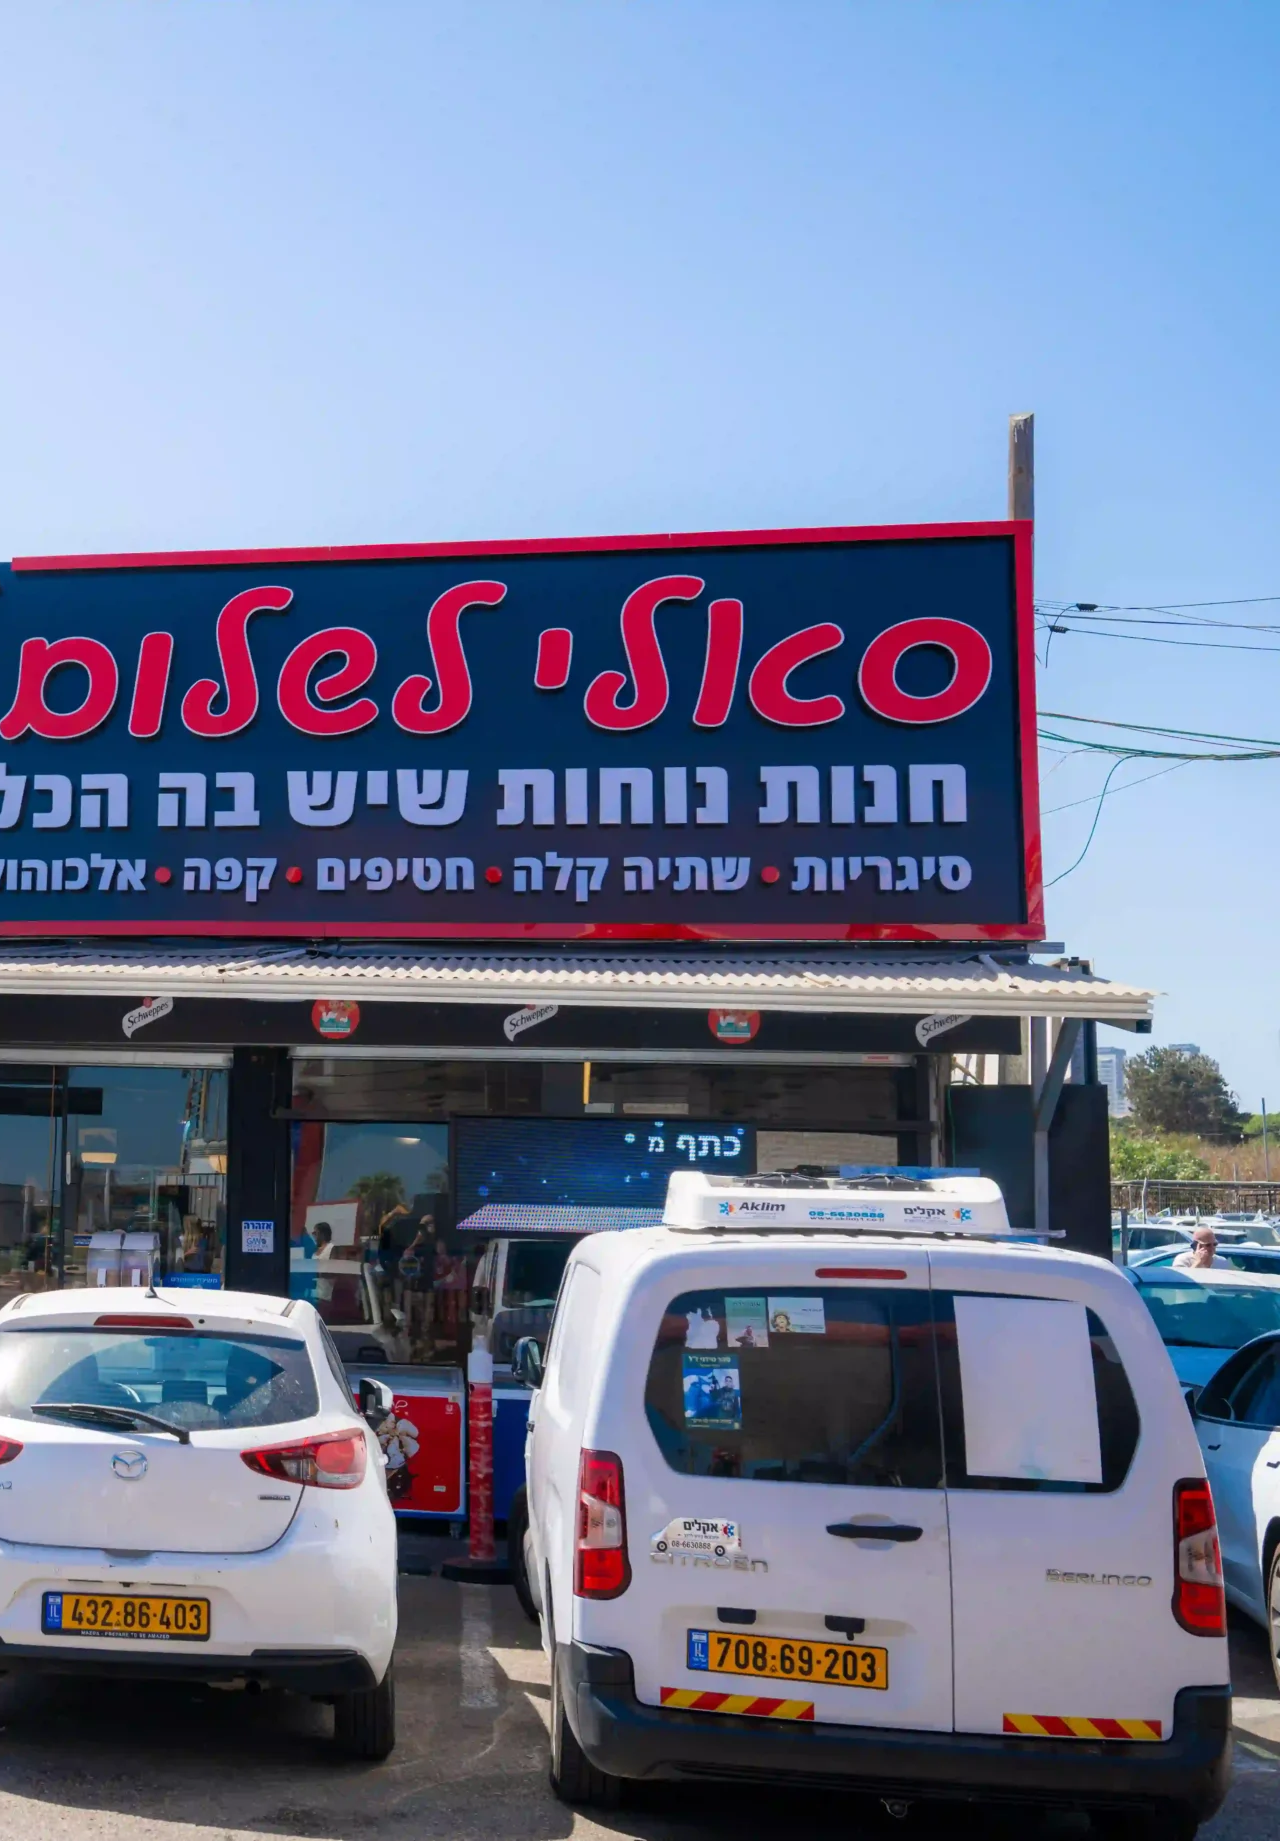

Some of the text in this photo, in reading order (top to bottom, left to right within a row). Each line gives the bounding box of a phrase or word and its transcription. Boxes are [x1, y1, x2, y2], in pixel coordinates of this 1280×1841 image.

[534, 574, 992, 731] סאלי
[157, 772, 260, 827] בה
[287, 769, 469, 827] שיש
[496, 766, 728, 826] נוחות
[759, 764, 967, 824] חנות
[183, 857, 278, 903] קפה
[316, 857, 475, 892] חטיפים
[513, 852, 609, 903] קלה
[623, 857, 750, 892] שתיה
[791, 856, 972, 892] סיגריות
[127, 1000, 169, 1029] Schweppes
[509, 1004, 554, 1032] Schweppes
[676, 1134, 741, 1161] כתף
[739, 1202, 785, 1211] Aklim
[904, 1206, 946, 1217] אקלים
[244, 1222, 272, 1230] אזהרה
[683, 1519, 719, 1534] אקלים
